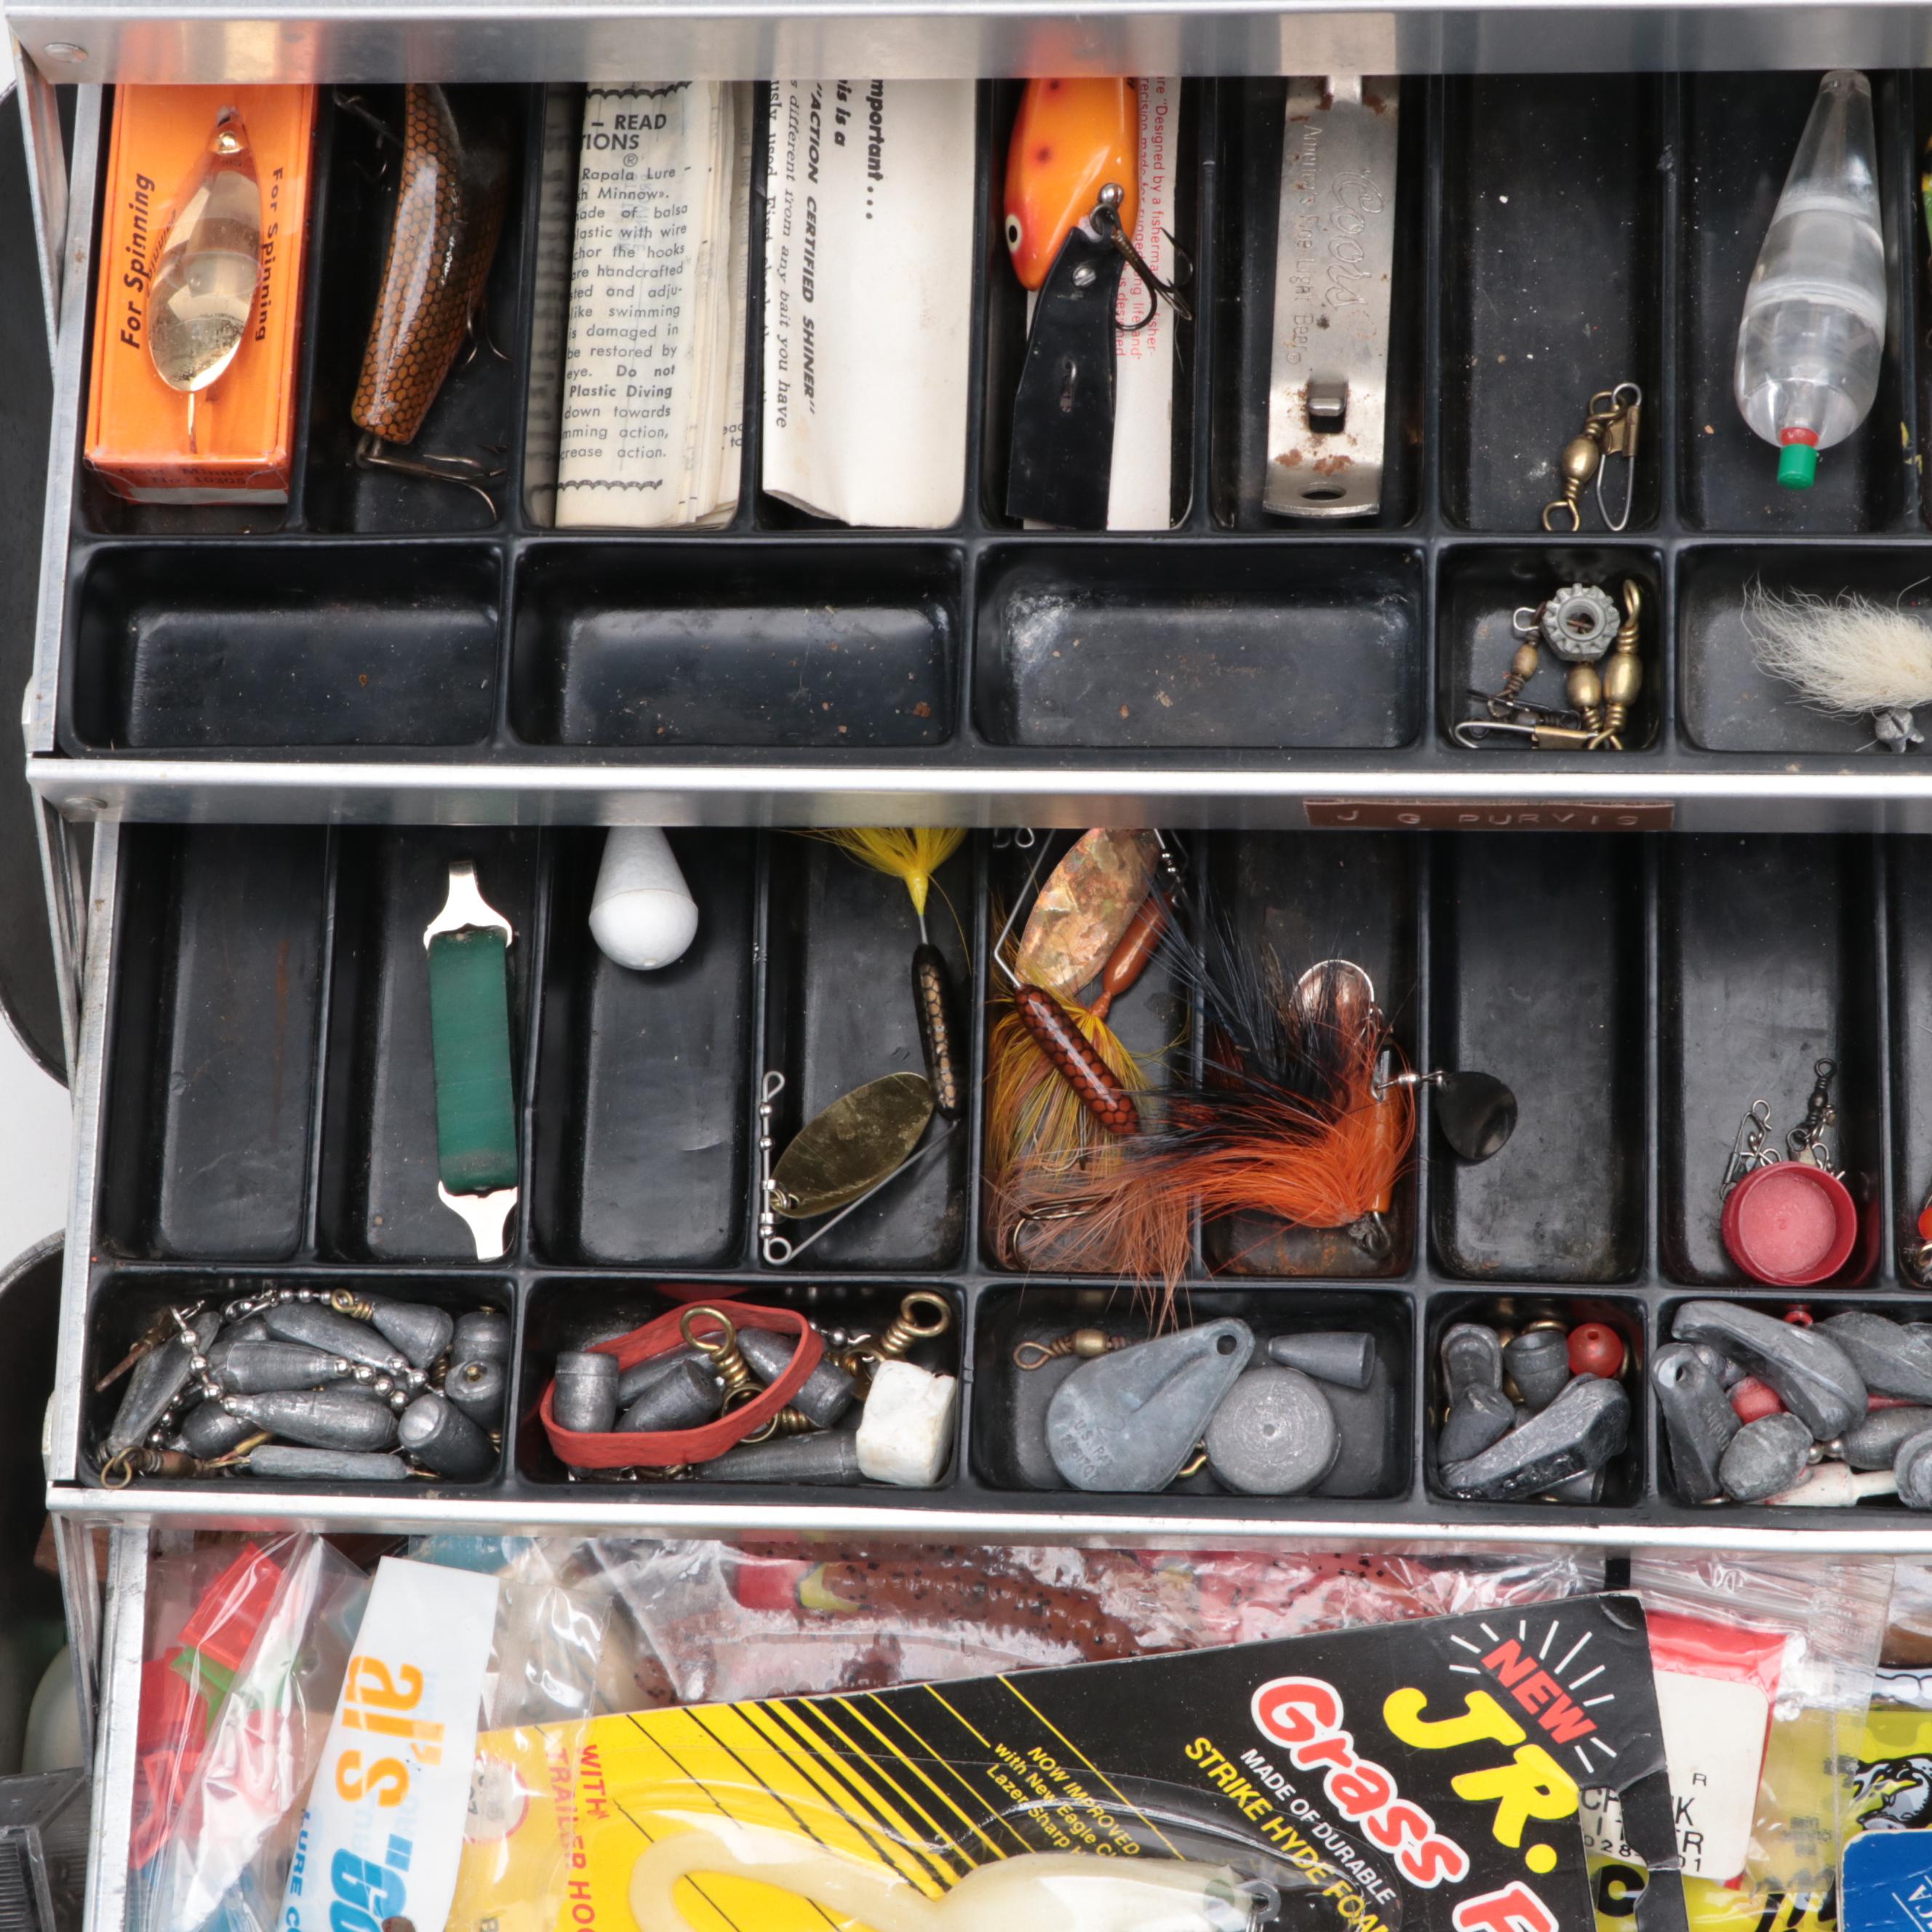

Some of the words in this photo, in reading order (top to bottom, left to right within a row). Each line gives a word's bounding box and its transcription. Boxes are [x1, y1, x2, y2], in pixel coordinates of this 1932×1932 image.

[615, 113, 667, 130] READ
[785, 95, 800, 182] different
[807, 82, 823, 184] "ACTION
[834, 130, 846, 147] a
[270, 167, 282, 212] For
[582, 168, 634, 182] Rapala
[647, 167, 676, 180] Lure
[1150, 175, 1165, 192] by
[621, 206, 638, 219] of
[655, 204, 688, 219] balsa
[783, 188, 794, 236] from
[1151, 197, 1161, 205] a
[124, 173, 155, 292] Spinning
[620, 226, 652, 239] with
[660, 223, 687, 237] wire
[802, 195, 818, 303] CERTIFIED
[613, 244, 636, 258] the
[647, 243, 685, 259] hooks
[777, 244, 790, 283] any
[255, 222, 279, 341] Spinning
[571, 269, 589, 282] are
[597, 262, 684, 280] handcrafted
[606, 284, 635, 298] and
[647, 285, 682, 300] adju-
[779, 290, 791, 328] bait
[121, 301, 142, 349] For
[608, 305, 681, 319] swimming
[1133, 303, 1145, 324] life
[569, 327, 577, 340] is
[586, 324, 658, 341] damaged
[667, 323, 679, 335] in
[567, 348, 580, 360] be
[590, 345, 652, 359] restored
[662, 343, 678, 360] by
[777, 334, 789, 372] you
[802, 315, 815, 415] SHINER"
[567, 367, 592, 380] eye.
[616, 364, 637, 378] Do
[654, 364, 676, 377] not
[570, 384, 617, 398] Plastic
[626, 385, 673, 399] Diving
[776, 378, 791, 428] have
[564, 406, 600, 420] down
[614, 404, 671, 418] towards
[619, 425, 668, 439] action,
[617, 445, 666, 459] action.
[1337, 810, 1358, 821] J
[1397, 813, 1421, 825] G
[1457, 813, 1639, 826] PURVIS
[1480, 1638, 1597, 1744] NEW
[335, 1655, 445, 1808] al's
[580, 1744, 610, 1820] WITH
[994, 1742, 1028, 1776] with
[1024, 1771, 1057, 1803] New
[1055, 1803, 1097, 1844] Eagle
[1250, 1675, 1470, 1889] Grass
[1383, 1687, 1579, 1874] JR.
[986, 1763, 1030, 1803] Lazer
[1027, 1804, 1071, 1848] Sharp
[1026, 1746, 1071, 1782] NOW
[1062, 1781, 1141, 1855] IMPROVED
[1184, 1736, 1274, 1821] STRIKE
[1260, 1816, 1336, 1885] HYDE
[546, 1747, 587, 1871] TRAILER
[567, 1880, 603, 1932] HO
[1240, 1748, 1297, 1802] MADE
[1289, 1798, 1321, 1826] OF
[1312, 1821, 1397, 1906] DURABLE
